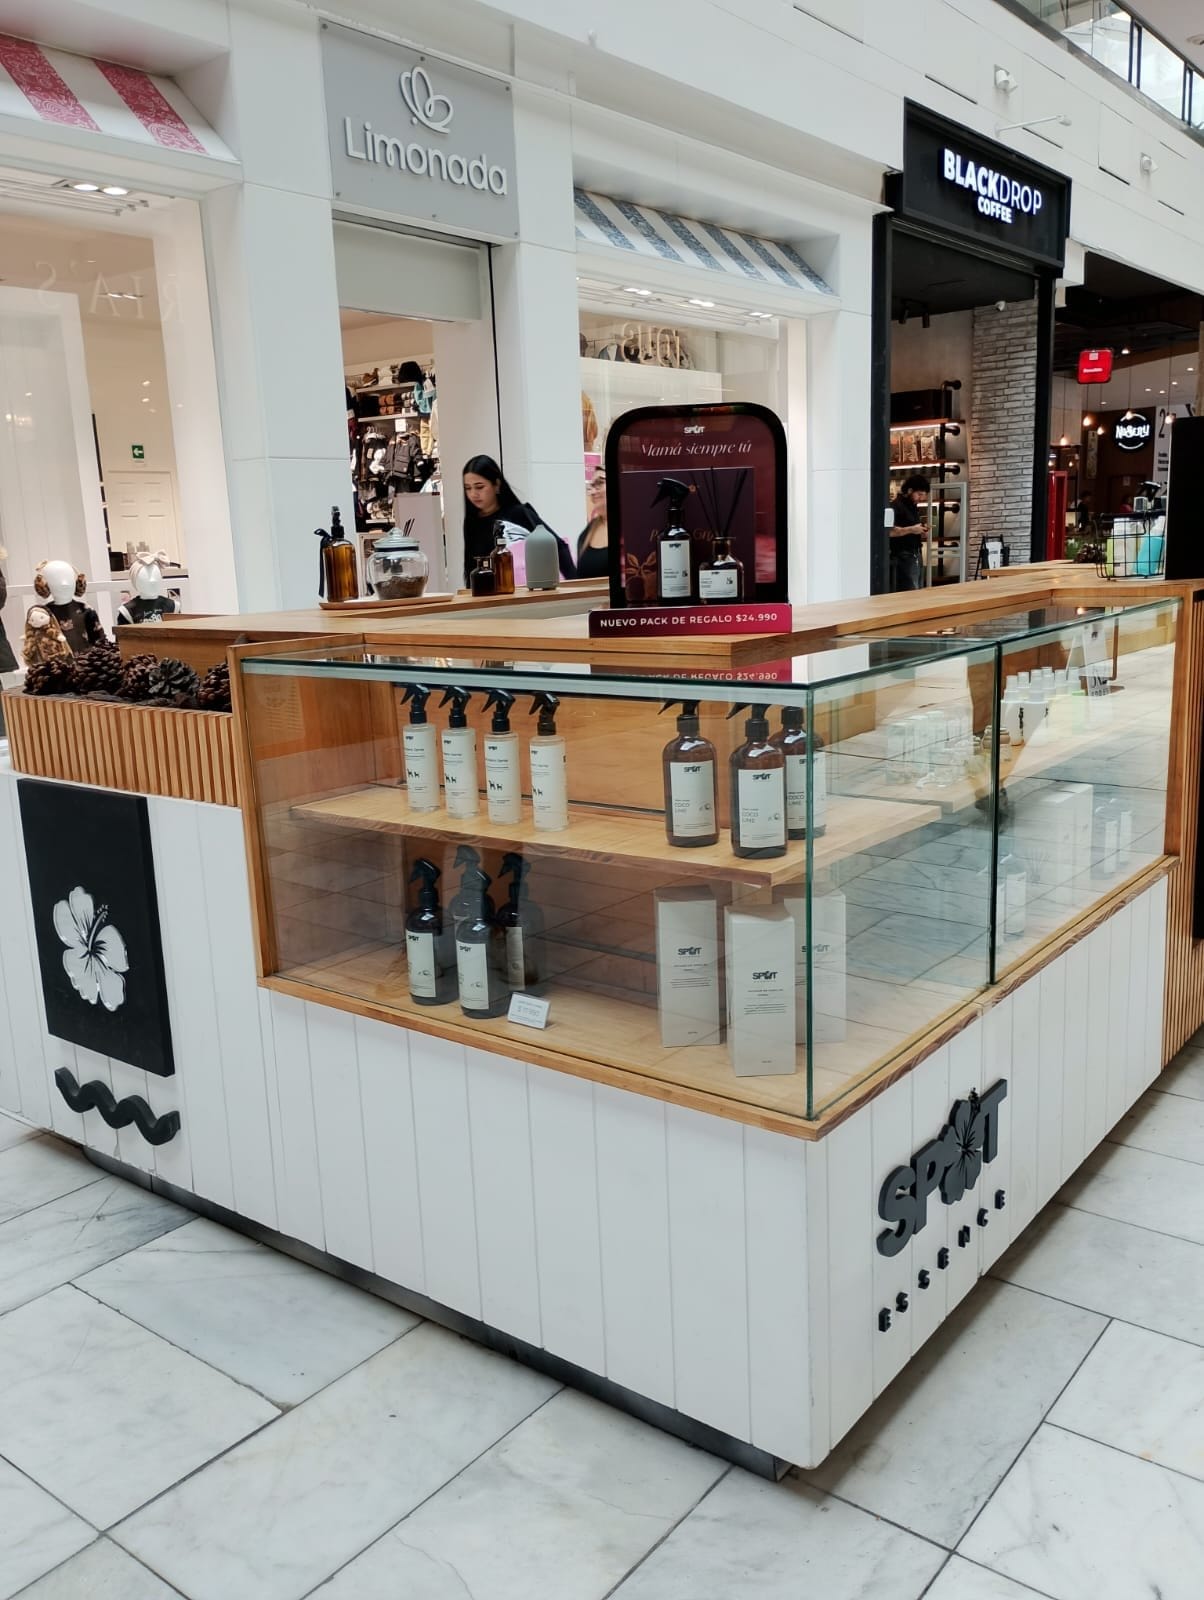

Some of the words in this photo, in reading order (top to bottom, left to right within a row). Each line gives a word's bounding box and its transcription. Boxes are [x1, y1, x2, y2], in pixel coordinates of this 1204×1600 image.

[344, 117, 507, 195] Limonada
[978, 196, 1012, 223] COFFEE
[642, 442, 682, 457] Mamá
[685, 442, 735, 457] siempre
[738, 439, 752, 453] tú
[600, 618, 637, 628] NUEVO
[640, 617, 668, 626] PACK
[671, 616, 686, 624] DE
[689, 614, 732, 624] REGALO
[735, 612, 778, 623] $24.990
[878, 1189, 1006, 1332] ESSENCE
